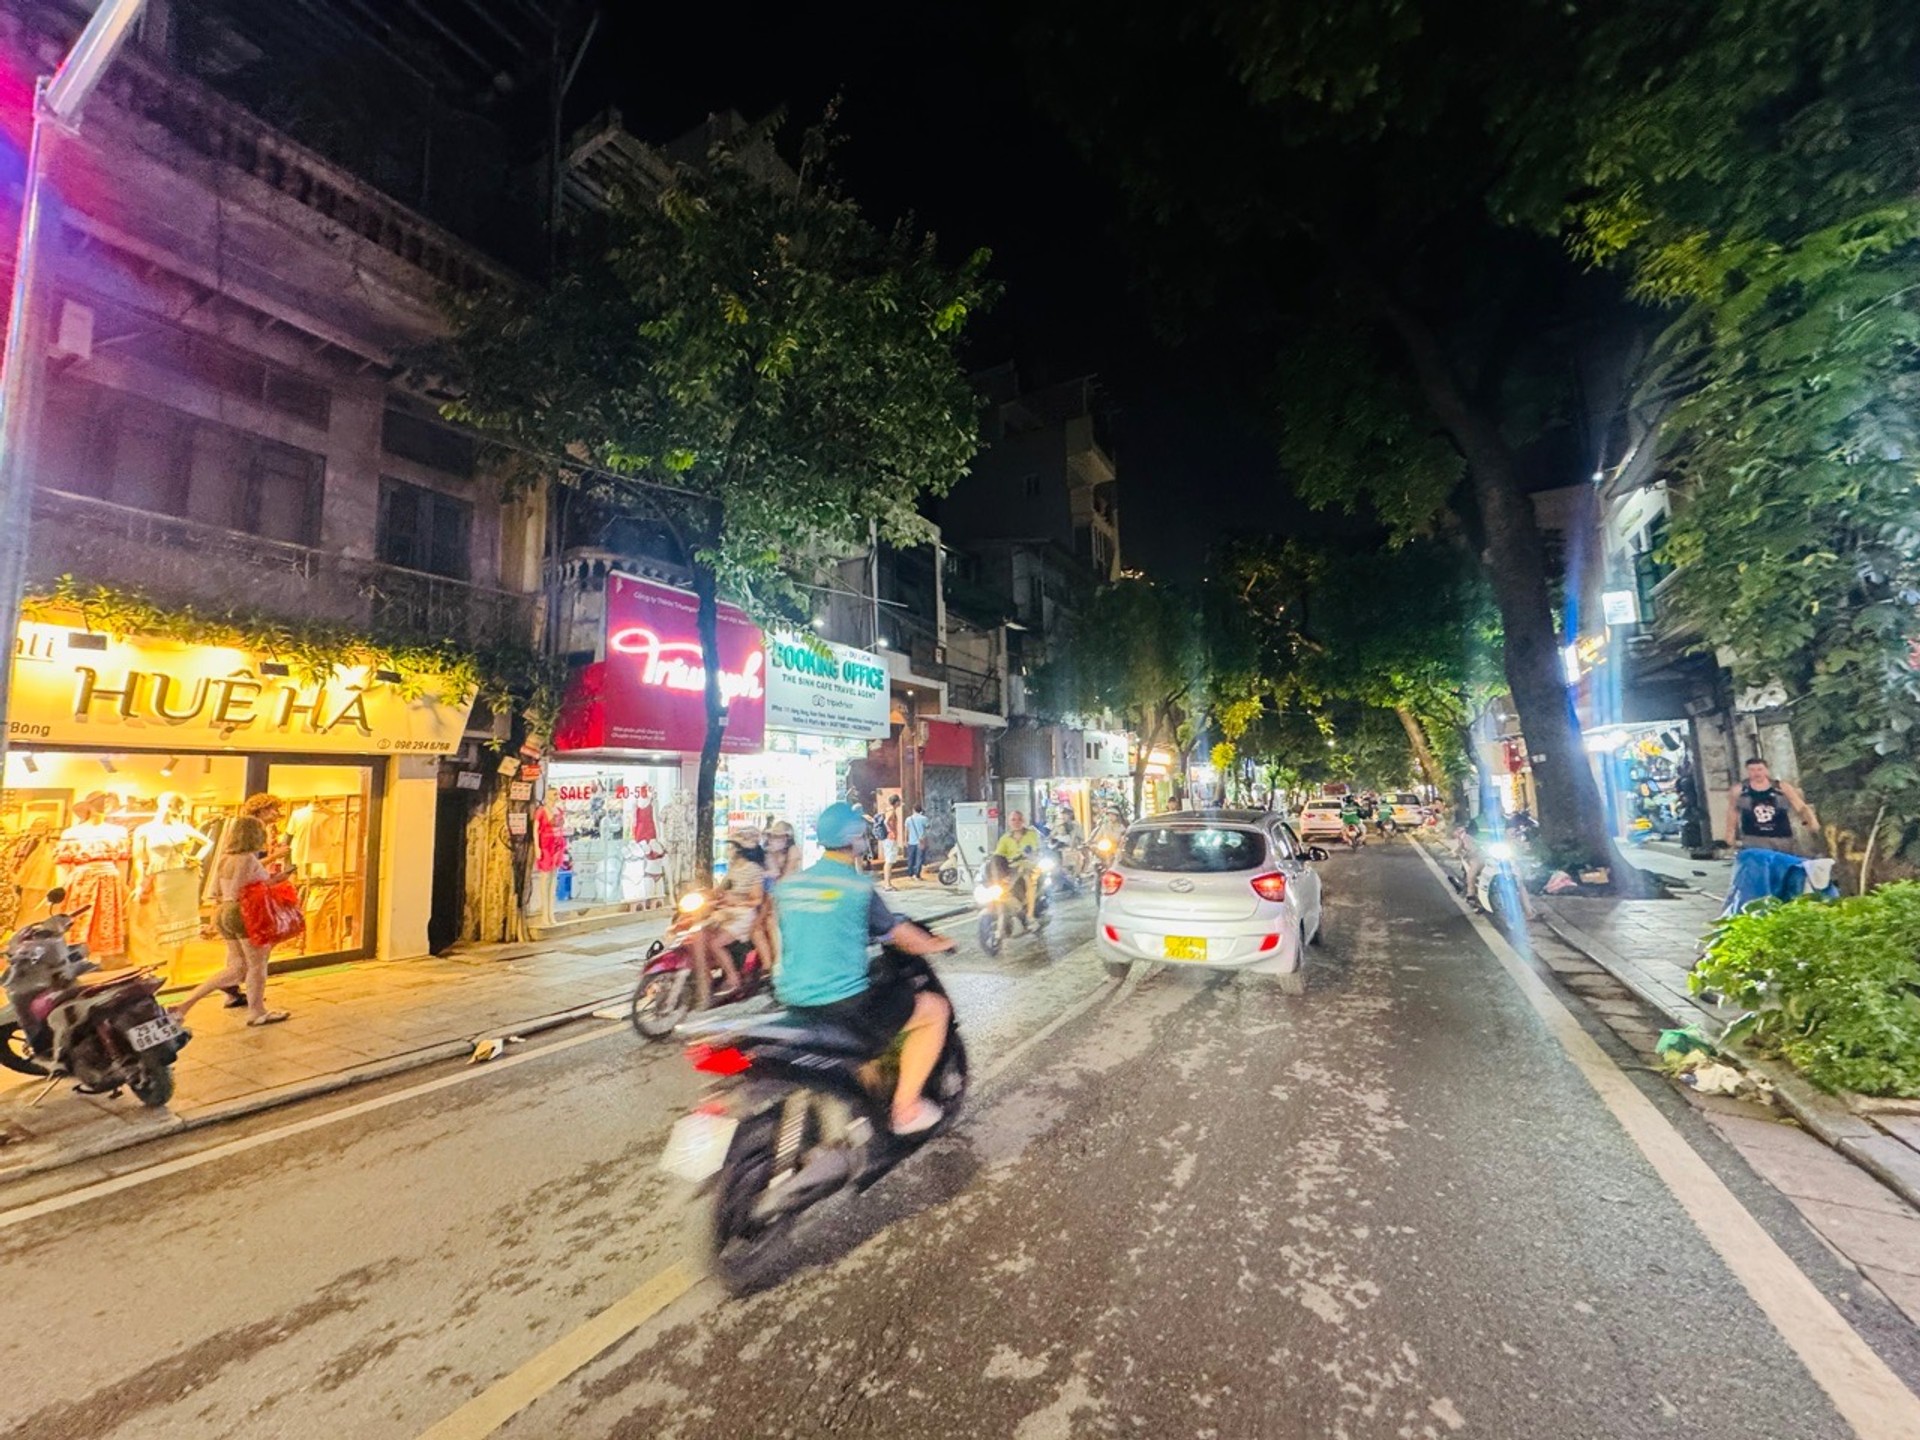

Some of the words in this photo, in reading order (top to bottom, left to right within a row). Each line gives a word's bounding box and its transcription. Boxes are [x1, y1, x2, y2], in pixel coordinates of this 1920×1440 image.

[772, 640, 839, 680] BOOKING
[843, 660, 885, 691] OFFICE
[75, 666, 262, 733] HUỆ
[782, 673, 796, 685] THE
[858, 690, 876, 701] AGENT
[559, 786, 591, 800] SALE
